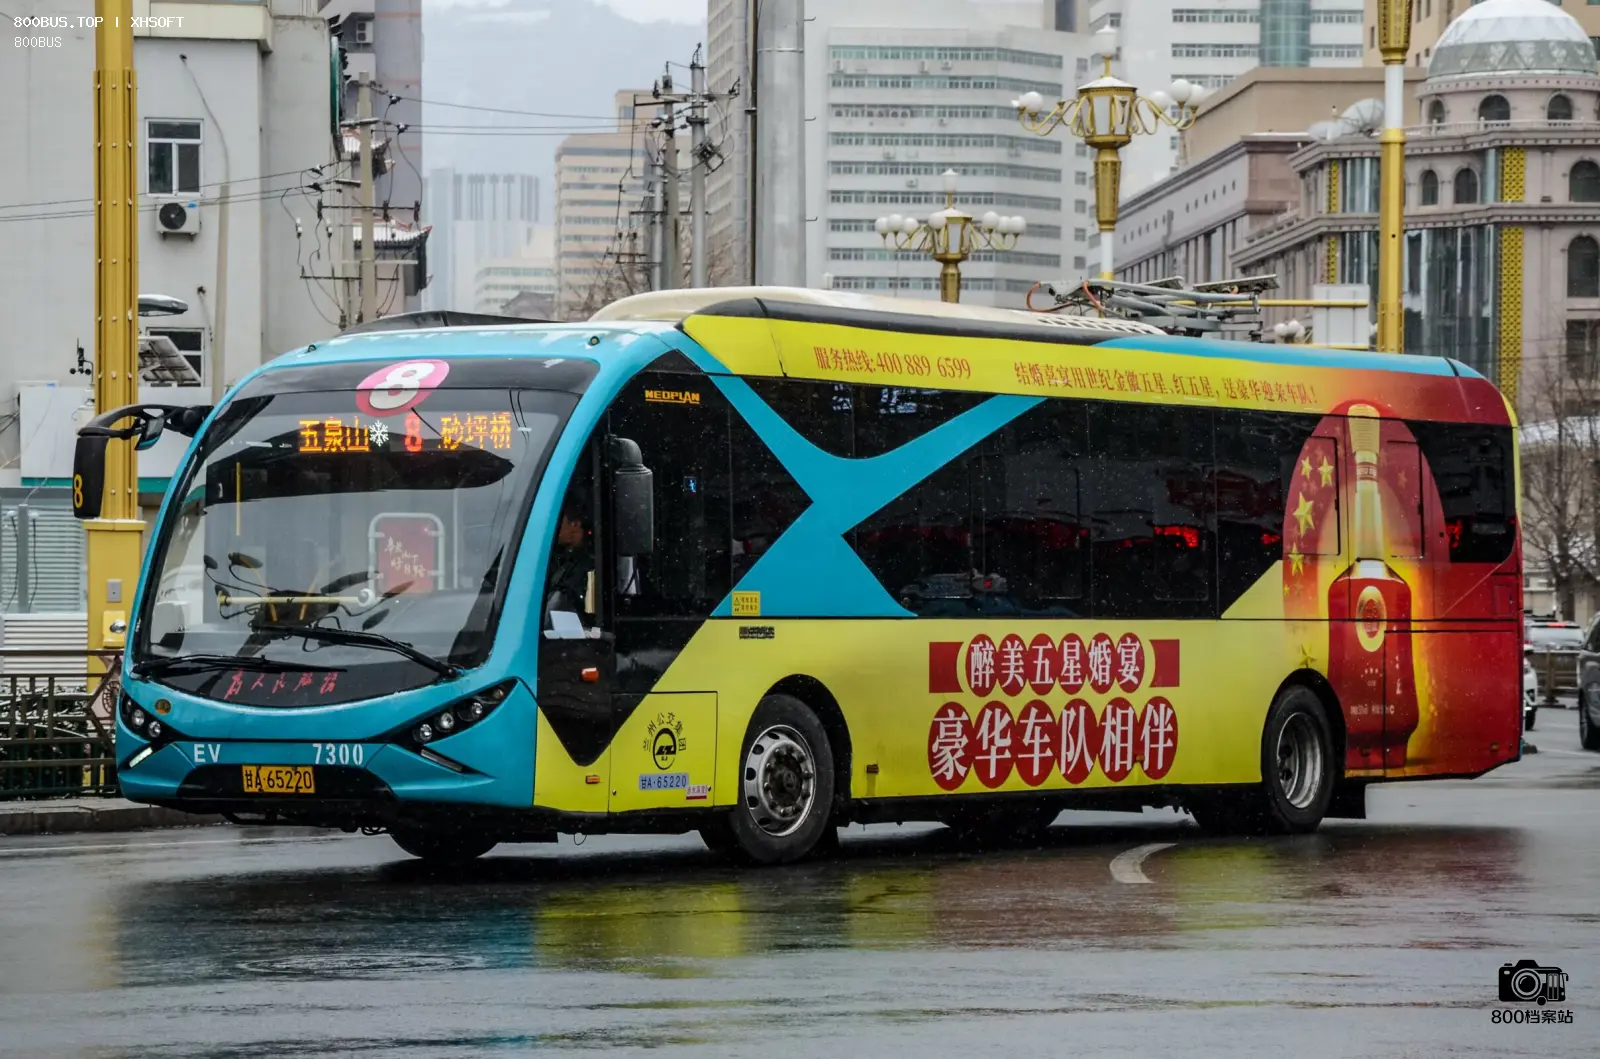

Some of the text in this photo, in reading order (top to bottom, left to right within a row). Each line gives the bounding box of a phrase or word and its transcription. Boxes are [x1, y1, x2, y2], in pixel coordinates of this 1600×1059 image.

[368, 362, 436, 410] 8
[904, 354, 932, 377] 889
[936, 356, 972, 380] 6599
[645, 390, 700, 404] NEOPLAN
[299, 411, 512, 452] 五泉山 8 砂坪桥
[73, 473, 83, 509] 8
[970, 637, 1141, 689] 醉美五星婚宴
[193, 743, 364, 765] EV 7300
[931, 703, 1175, 781] 豪华车队相伴
